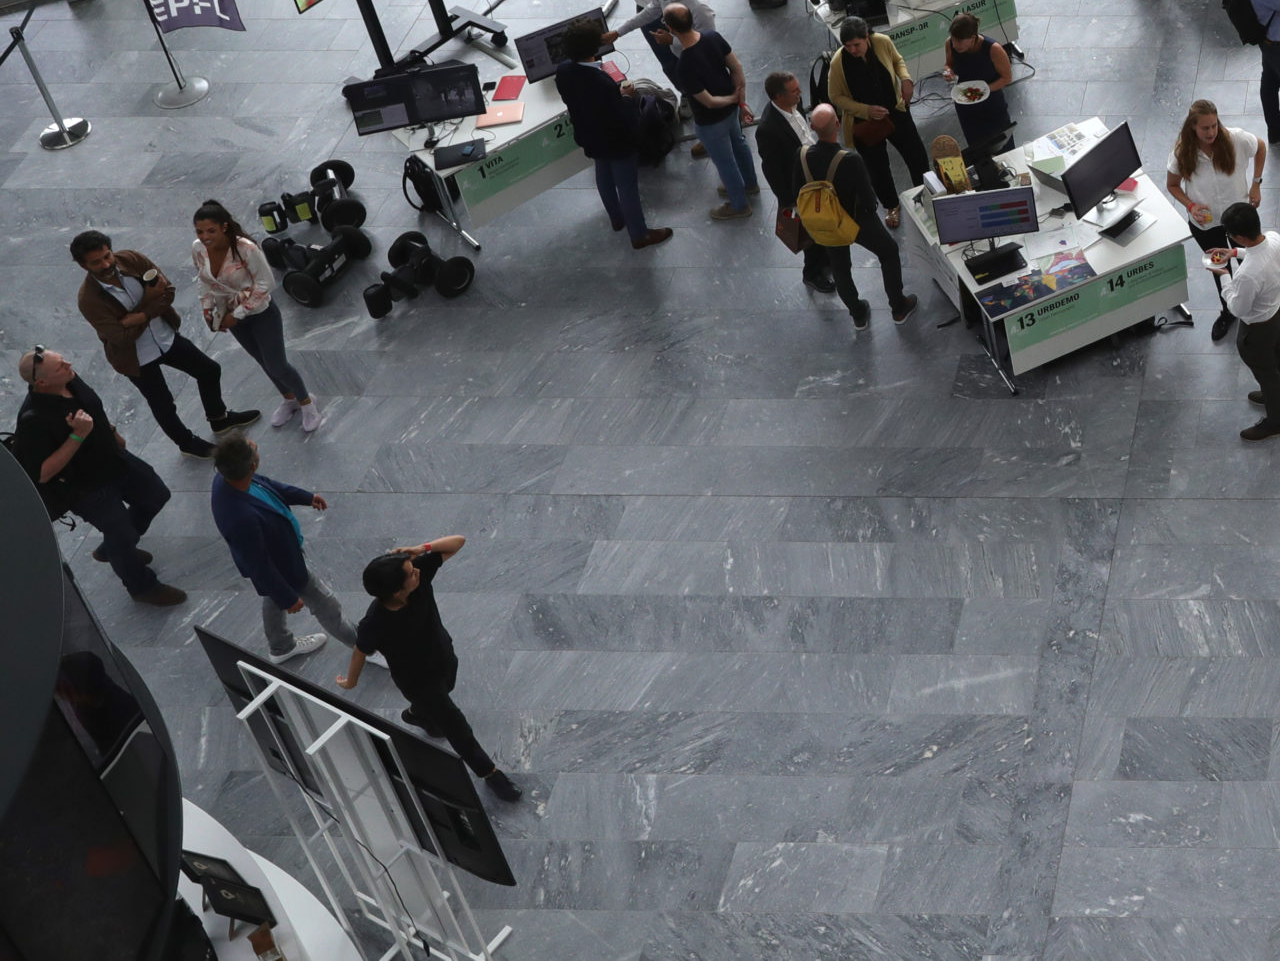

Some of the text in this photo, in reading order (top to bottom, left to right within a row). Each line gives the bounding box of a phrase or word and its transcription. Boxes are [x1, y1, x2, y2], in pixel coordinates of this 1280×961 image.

[890, 21, 929, 41] RANSP-OR
[554, 123, 566, 138] 2
[477, 165, 487, 179] 1
[486, 156, 504, 169] VITA
[1107, 274, 1126, 292] 14
[1126, 261, 1155, 278] URBES
[1017, 312, 1036, 330] 13
[1037, 293, 1080, 316] URBDEMO
